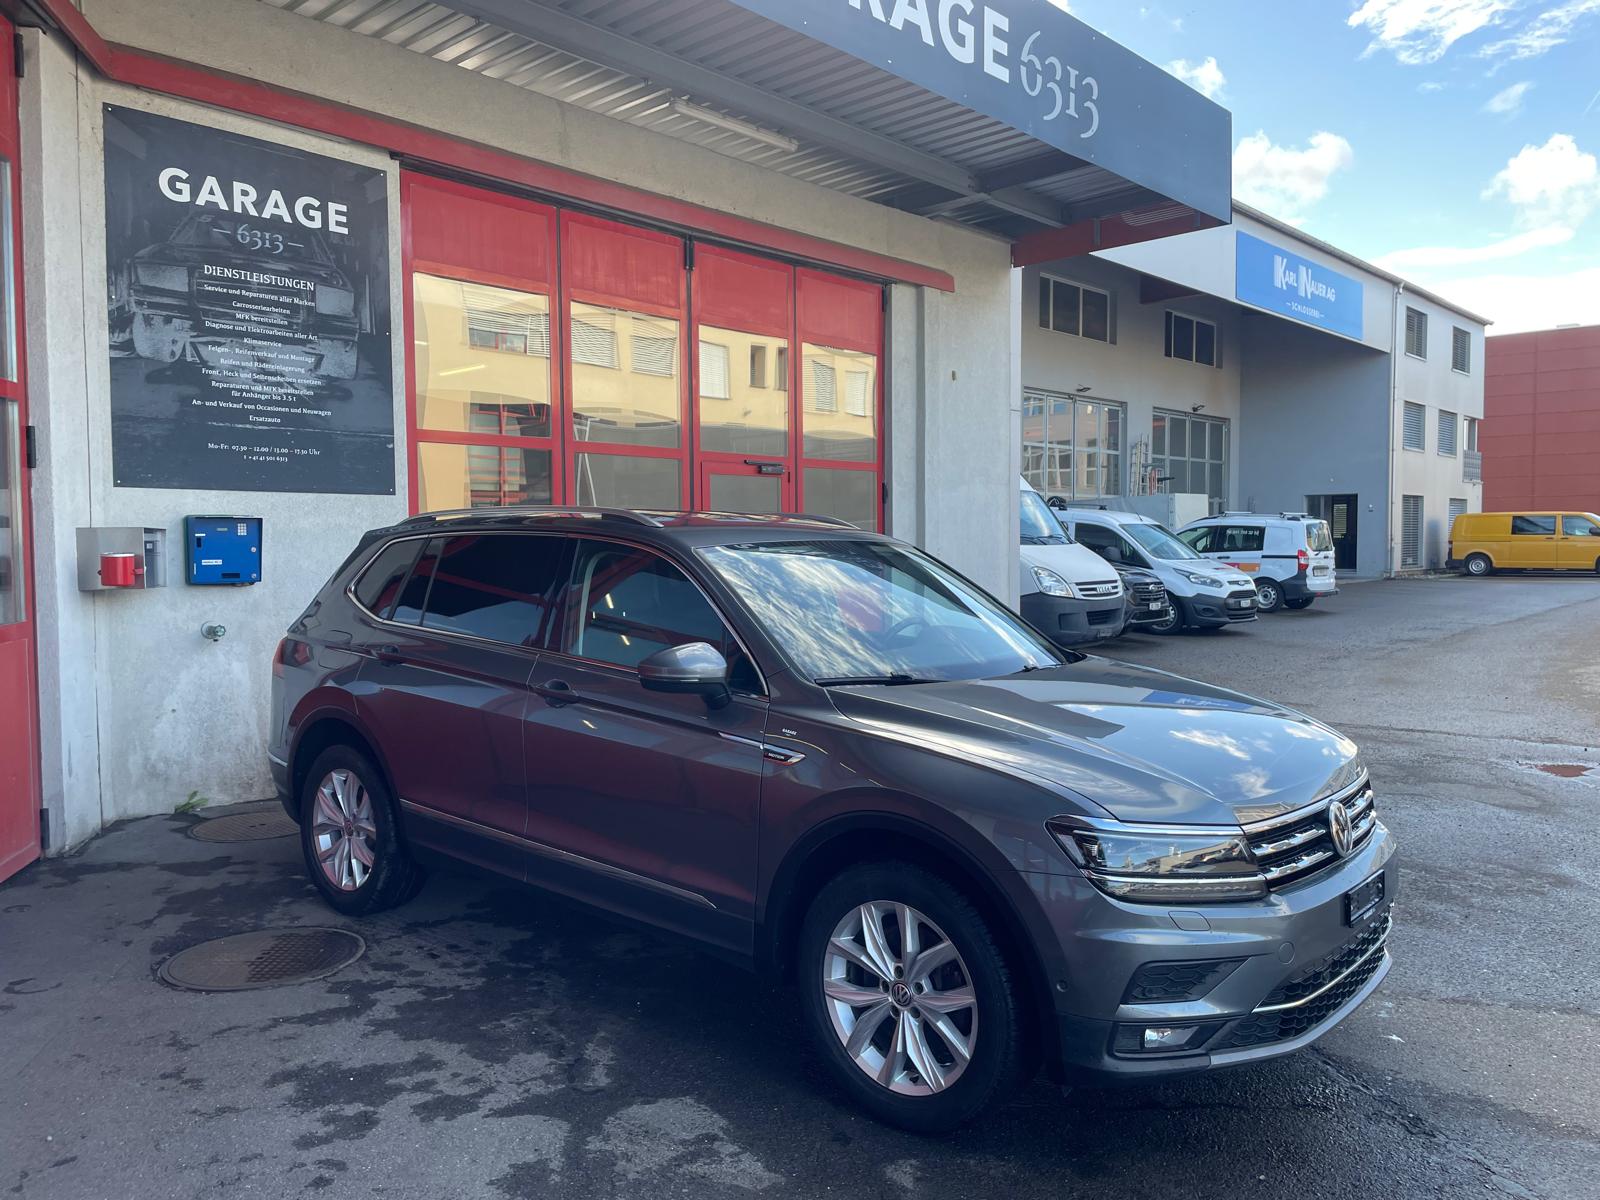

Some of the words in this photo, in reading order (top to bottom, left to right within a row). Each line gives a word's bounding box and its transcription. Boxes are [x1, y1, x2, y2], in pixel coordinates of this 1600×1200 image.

[1020, 30, 1099, 138] 6313
[158, 167, 349, 235] GARAGE
[237, 223, 283, 254] 6313
[204, 264, 314, 291] DIENSTLEISTUNGEN
[204, 284, 227, 294] Service
[228, 287, 240, 295] und
[241, 289, 278, 301] Reparaturen
[279, 295, 293, 303] aller
[293, 298, 315, 307] Marken
[232, 300, 291, 315] Carrosseriearbeiten
[236, 312, 250, 321] MFK
[251, 314, 288, 325] bereitstellen
[205, 320, 234, 330] Diagnose
[235, 324, 247, 332] und
[248, 325, 293, 338] Elektroarbeiten
[308, 333, 318, 341] Art
[243, 337, 282, 348] Klimaservice
[220, 358, 240, 366] Reifen
[241, 359, 253, 367] und
[235, 347, 278, 359] Reifenverkauf
[278, 351, 290, 360] und
[290, 353, 315, 363] Montage
[223, 369, 239, 377] Heck
[240, 371, 252, 379] und
[252, 372, 297, 384] Seitenscheiben
[297, 378, 322, 387] ersetzen
[211, 380, 250, 391] Reparaturen
[250, 384, 263, 392] und
[263, 384, 278, 393] MFK
[278, 385, 314, 396] bereitstellen
[231, 390, 241, 398] für
[241, 391, 272, 400] Anhänger
[192, 398, 204, 406] An-
[218, 401, 243, 410] Verkauf
[256, 403, 290, 413] Occasionen
[290, 406, 302, 414] und
[302, 407, 332, 417] Neuwagen
[249, 414, 281, 424] Ersatzauto
[309, 448, 321, 456] Uhr
